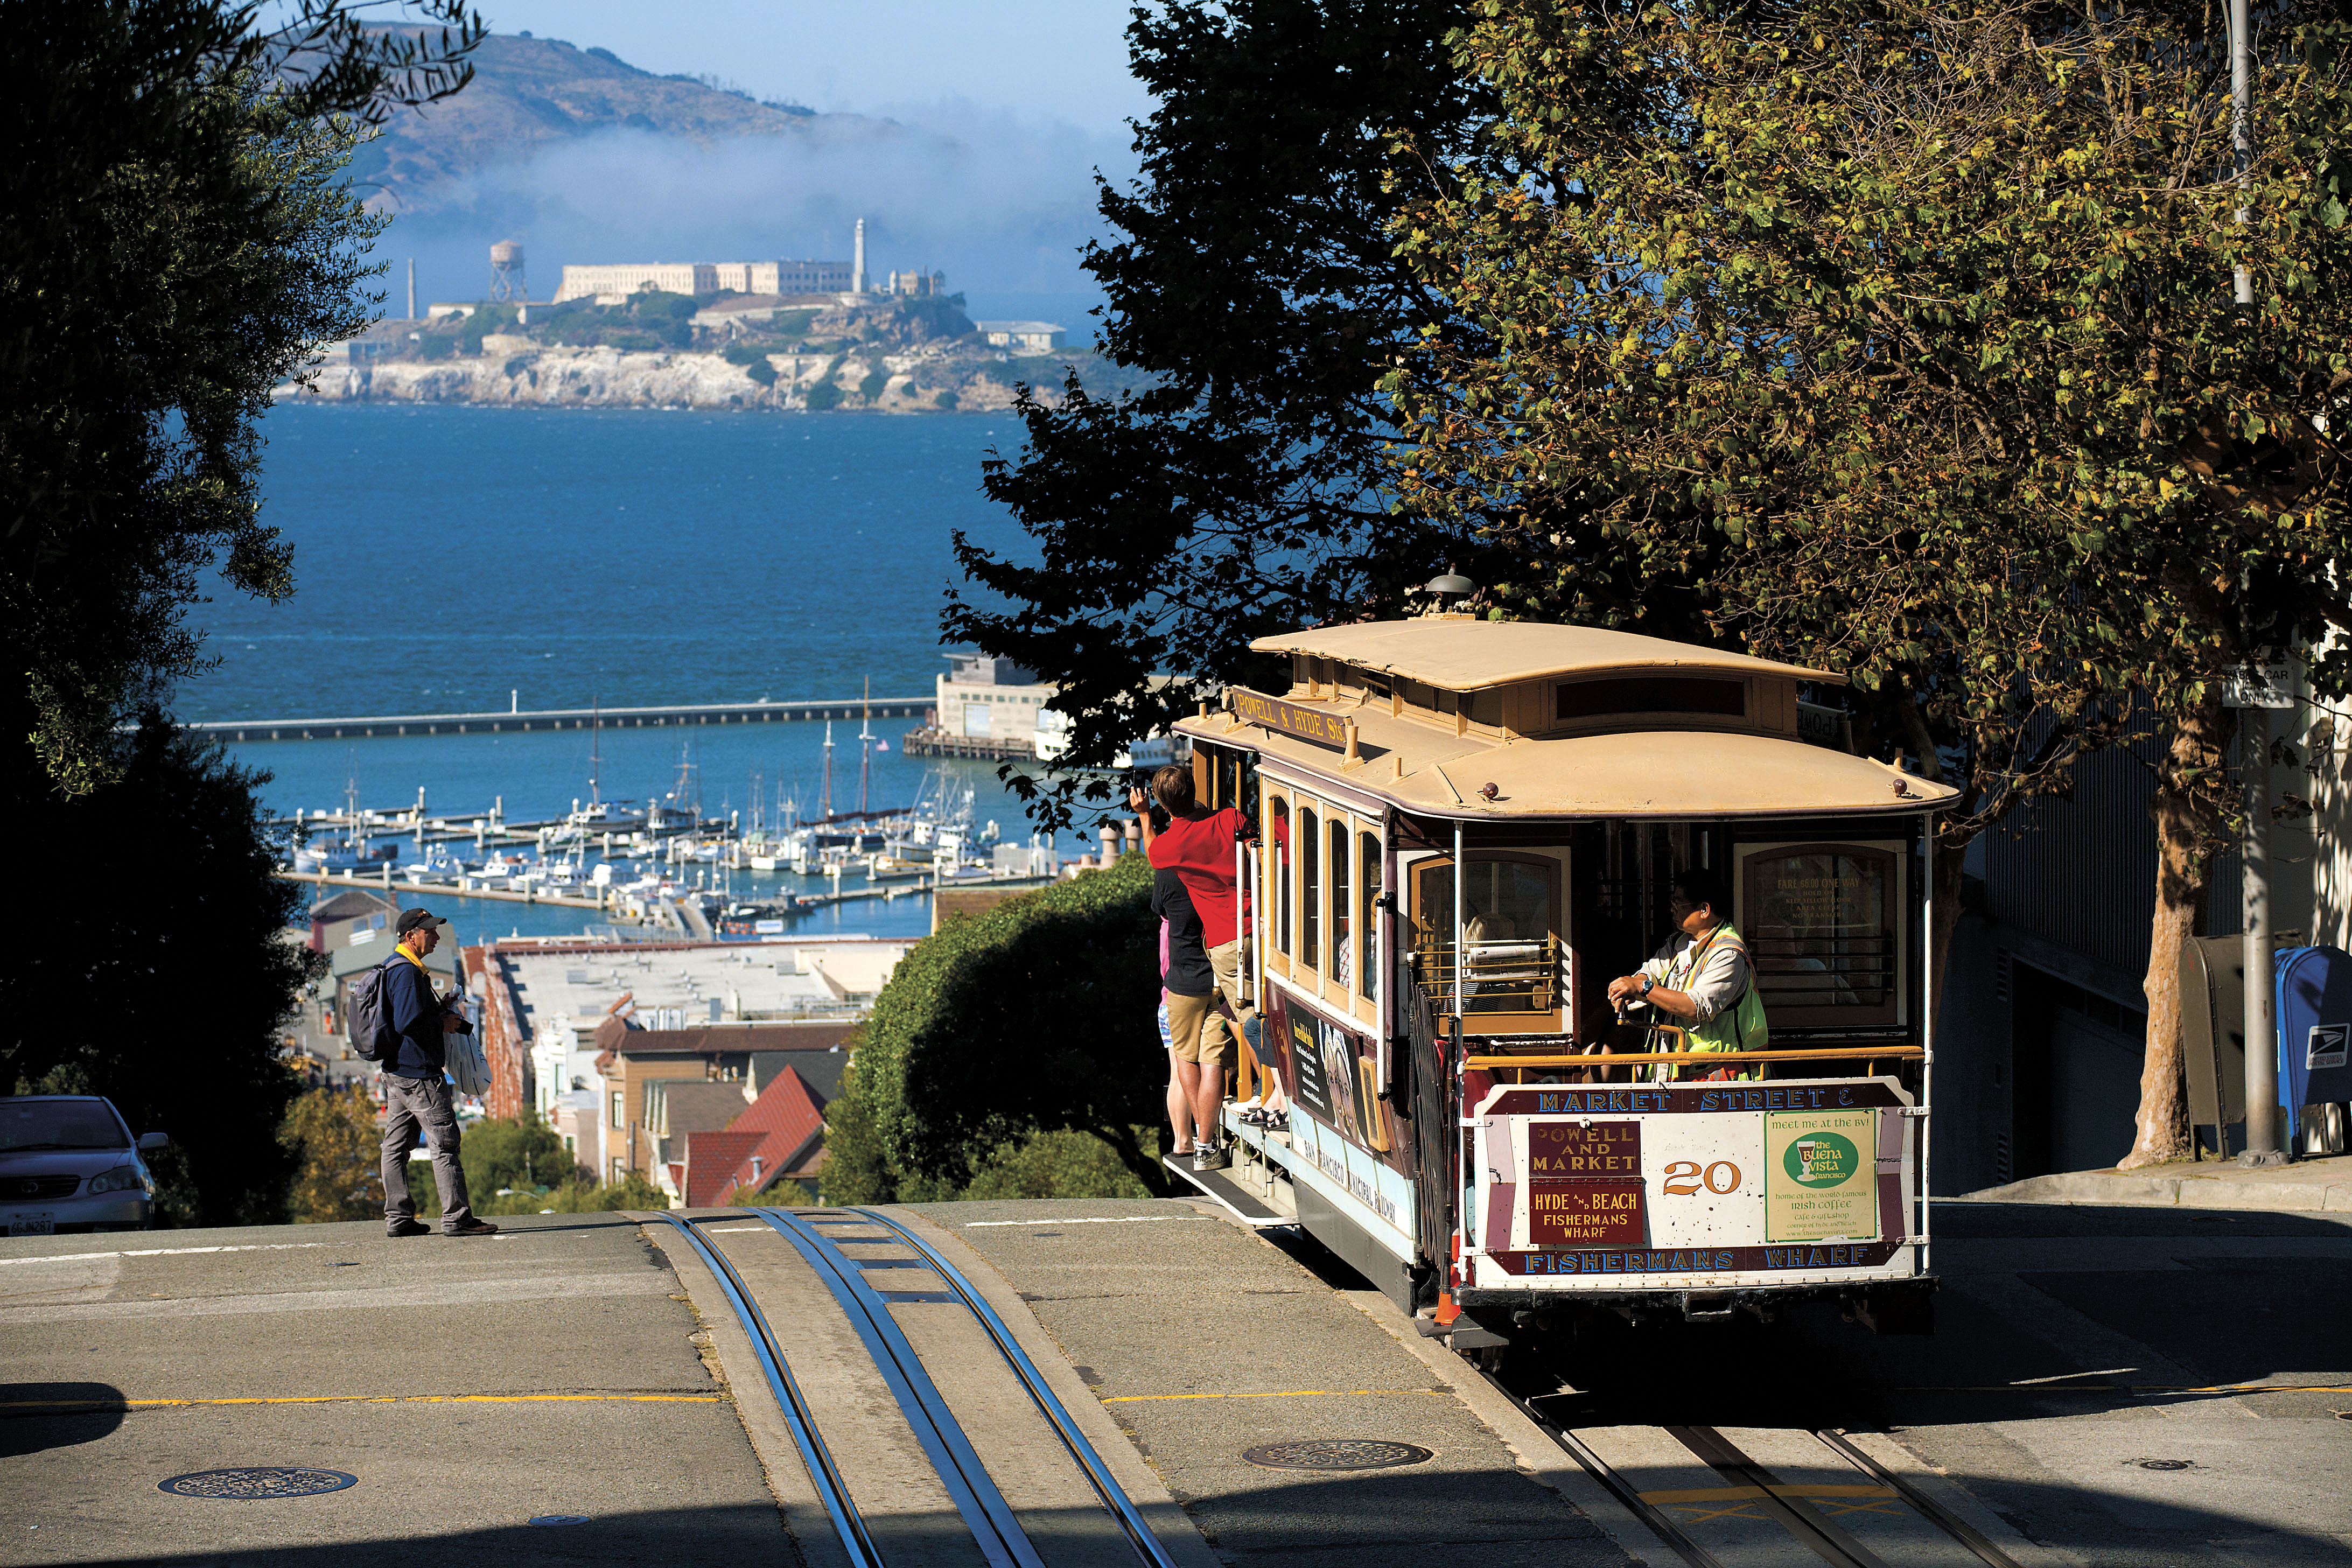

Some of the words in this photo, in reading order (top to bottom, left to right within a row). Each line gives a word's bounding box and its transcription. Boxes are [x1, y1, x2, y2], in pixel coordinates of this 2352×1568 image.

[2264, 670, 2288, 680] CAR
[2241, 692, 2269, 702] ONLY
[1237, 694, 1276, 723] POWELL
[1280, 706, 1290, 728] &
[1293, 709, 1324, 737] HYDE
[1327, 717, 1345, 742] Sts.
[1777, 879, 1797, 888] FARE
[1822, 878, 1839, 888] ONE
[1842, 878, 1860, 887] WAY
[1277, 1025, 1289, 1055] 20
[1539, 1092, 1671, 1112] MARKET
[1700, 1088, 1825, 1111] STREET
[1855, 1118, 1869, 1126] BV!
[1538, 1128, 1634, 1142] POWELL
[1561, 1144, 1611, 1154] AND
[1533, 1156, 1635, 1170] MARKET
[1304, 1139, 1315, 1162] SAN
[1318, 1149, 1345, 1184] RANCISCO
[1346, 1169, 1373, 1207] UNICIPAL
[1663, 1161, 1741, 1195] 20
[1535, 1194, 1569, 1210] HYDE
[1573, 1194, 1590, 1210] AND
[1592, 1193, 1637, 1210] BEACH
[1544, 1214, 1628, 1226] FISHERMANS
[1564, 1227, 1607, 1238] WHARF
[1524, 1250, 1733, 1274] FISHERMANS
[1765, 1245, 1868, 1268] WHARF
